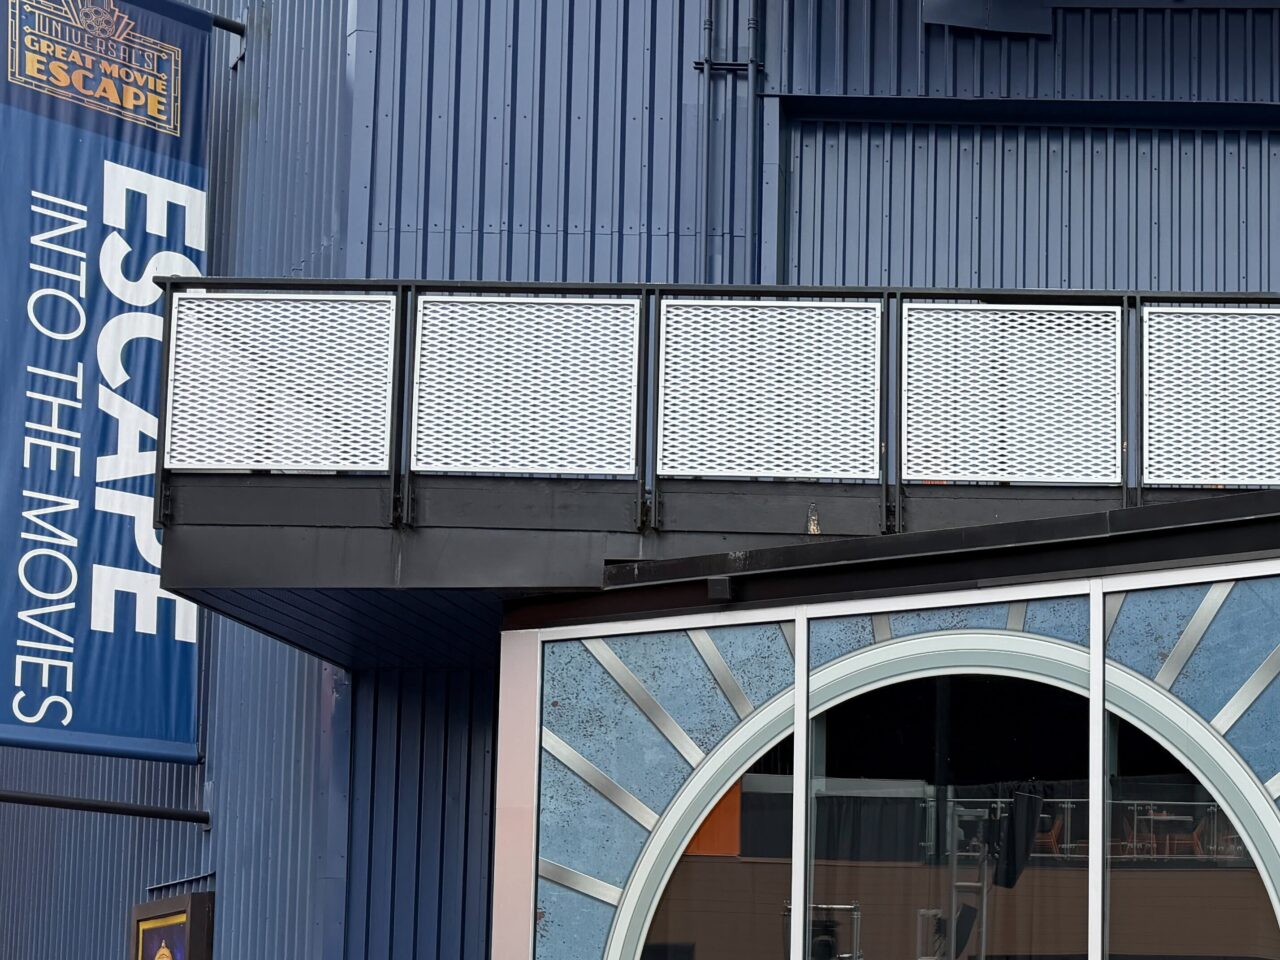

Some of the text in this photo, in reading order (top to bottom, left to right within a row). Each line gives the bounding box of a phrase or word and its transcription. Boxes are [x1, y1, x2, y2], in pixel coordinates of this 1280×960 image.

[24, 34, 168, 95] GREAT MOVIE
[38, 15, 153, 70] UNIVERSAL'S
[25, 51, 168, 121] ESCAPE
[12, 190, 87, 727] INTO THE MOVIES
